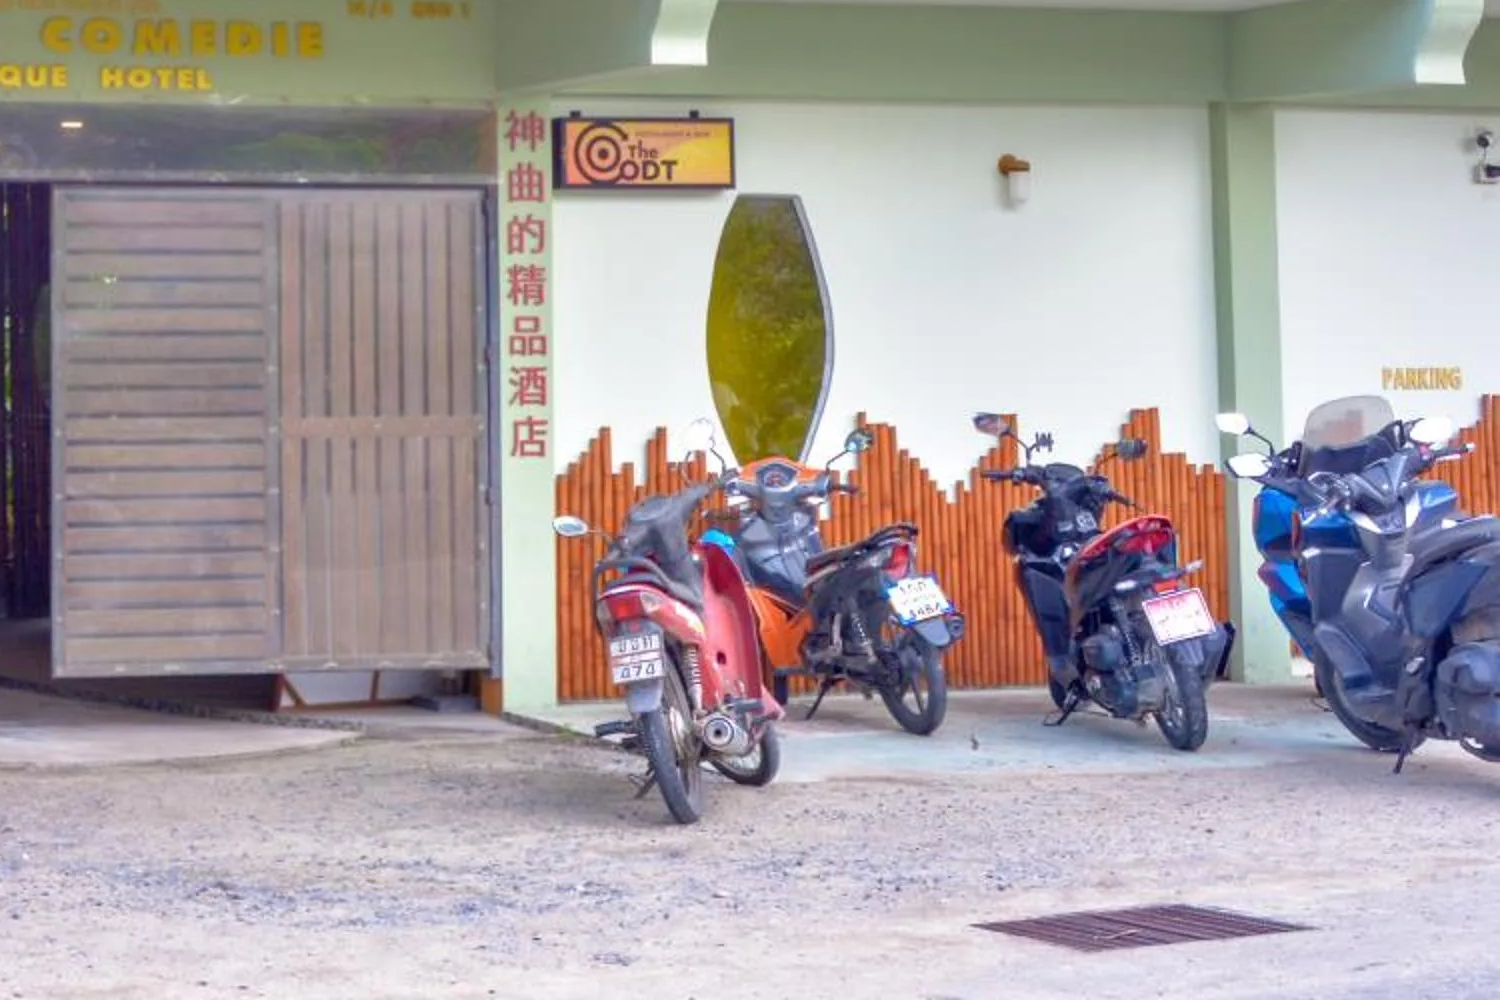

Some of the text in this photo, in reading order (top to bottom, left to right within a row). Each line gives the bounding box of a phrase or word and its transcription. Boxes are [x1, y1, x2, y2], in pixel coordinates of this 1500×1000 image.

[41, 17, 325, 57] COMEDIE
[100, 67, 213, 90] HOTEL
[504, 109, 548, 458] 神曲的精品酒店
[1381, 366, 1462, 390] PARKING
